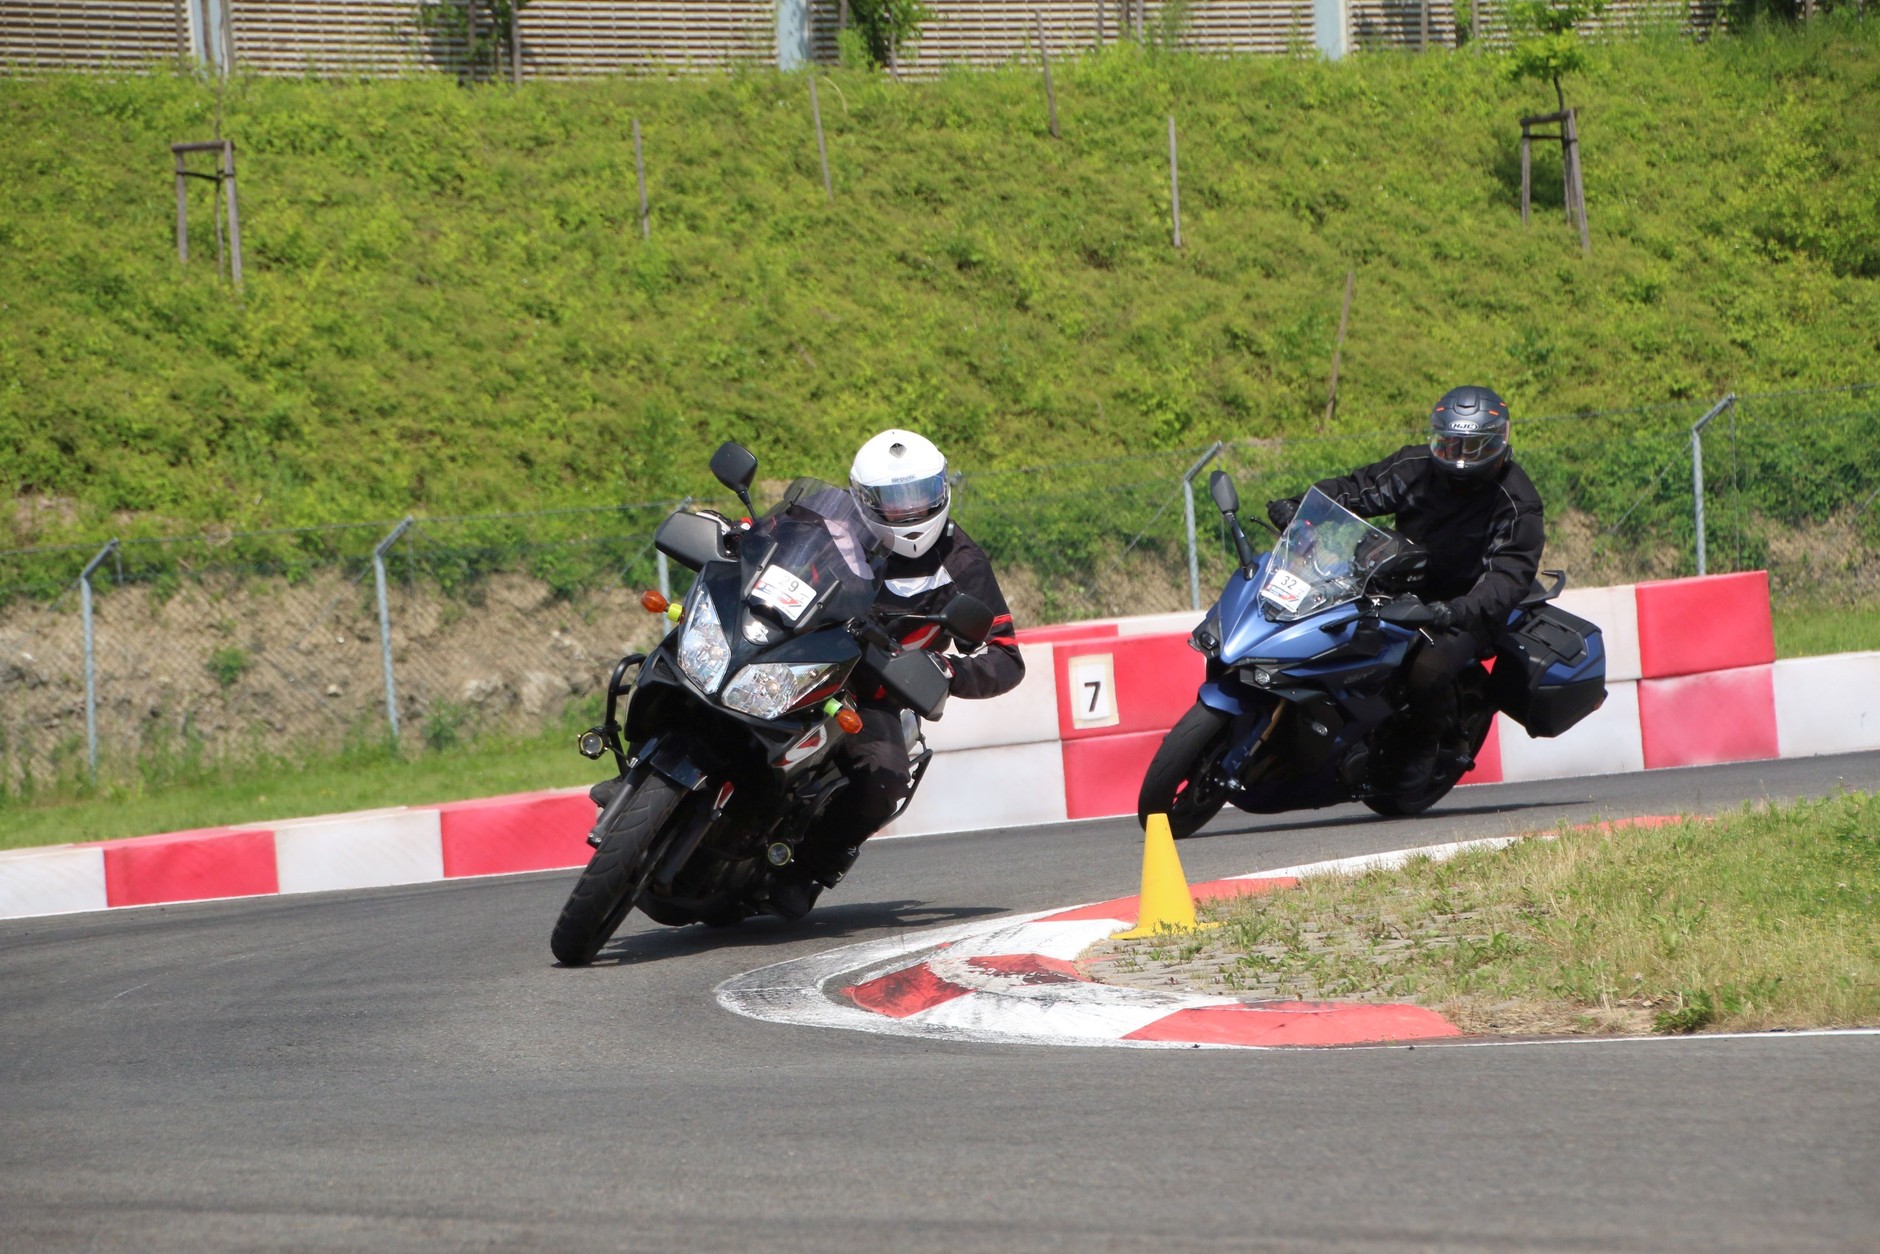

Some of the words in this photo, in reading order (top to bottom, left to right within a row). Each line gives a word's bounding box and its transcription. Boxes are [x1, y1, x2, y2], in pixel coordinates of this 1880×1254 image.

[778, 575, 800, 592] 29
[1280, 575, 1297, 590] 32
[1084, 680, 1101, 713] 7
